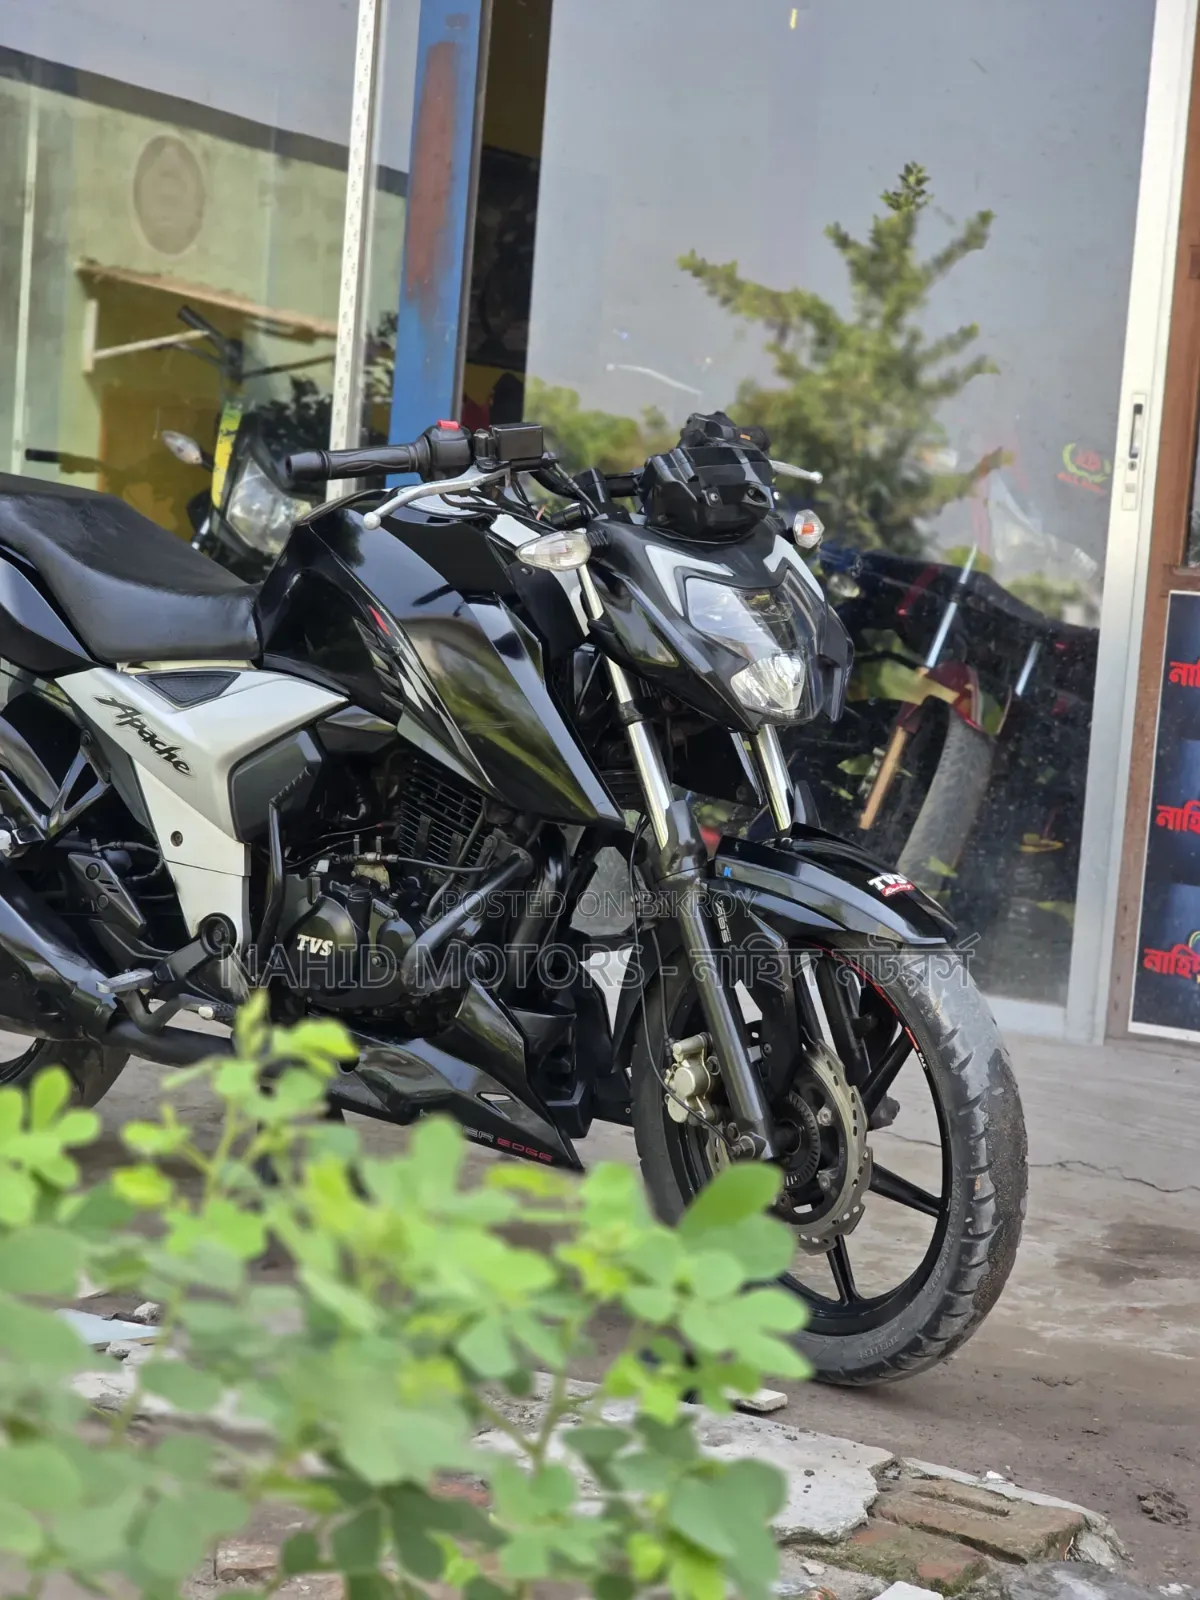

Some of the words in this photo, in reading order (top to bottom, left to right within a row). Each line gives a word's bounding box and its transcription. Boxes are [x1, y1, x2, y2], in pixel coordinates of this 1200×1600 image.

[93, 697, 192, 776] Apache
[867, 873, 908, 891] TVS
[296, 933, 334, 957] TVS
[496, 1137, 553, 1163] EDGE
